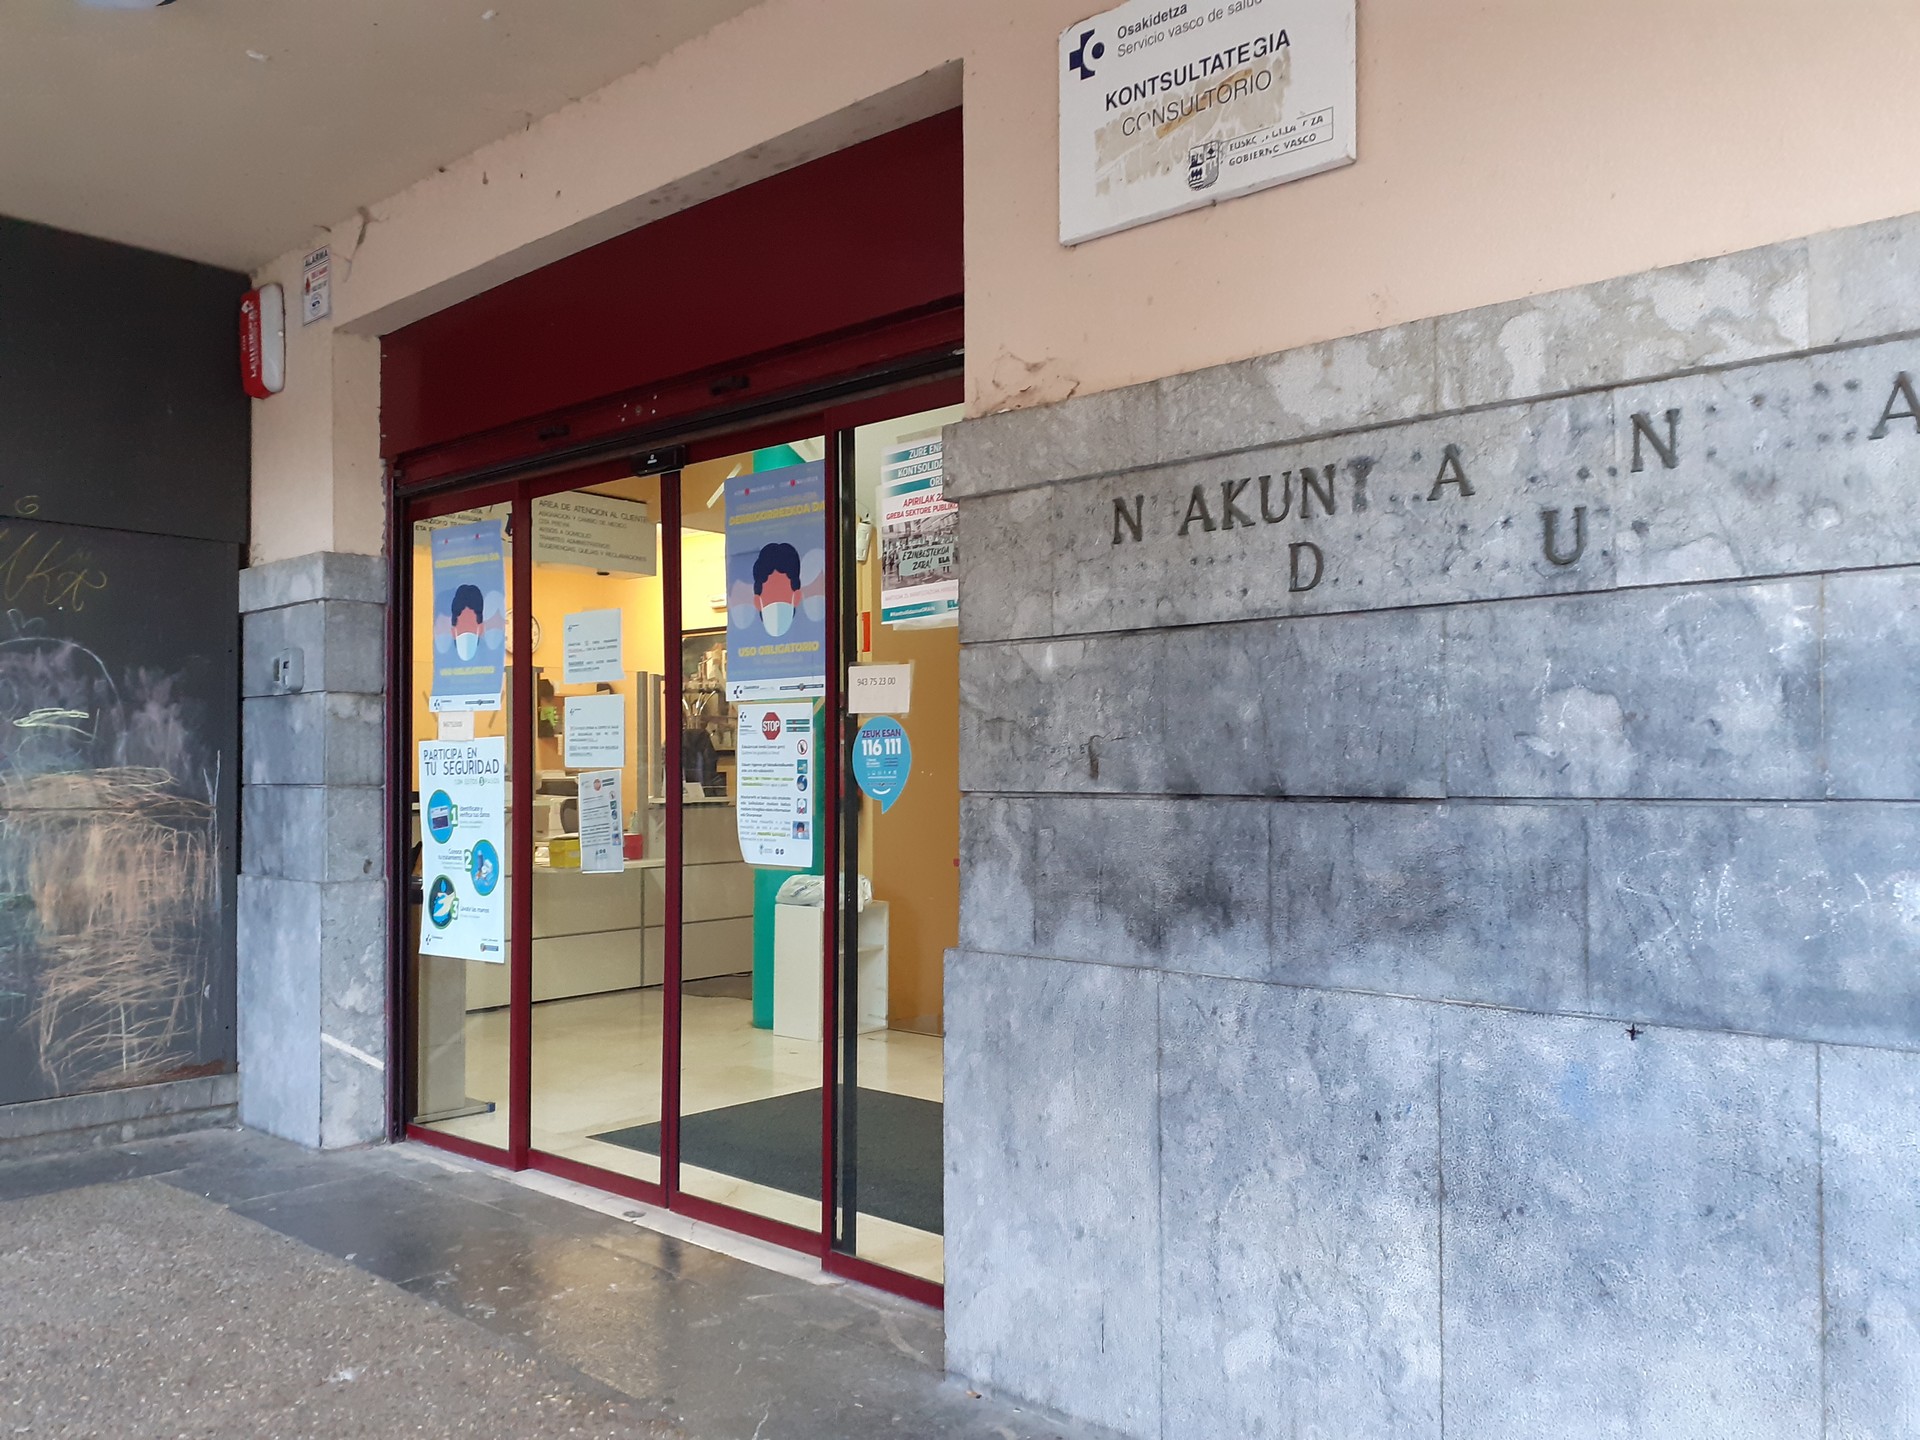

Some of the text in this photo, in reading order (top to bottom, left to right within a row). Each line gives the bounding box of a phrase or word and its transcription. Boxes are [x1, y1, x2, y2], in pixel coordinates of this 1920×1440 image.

[1117, 4, 1187, 39] Osakidetza
[1117, 31, 1165, 58] Servicio
[1167, 16, 1204, 38] vasco
[1208, 8, 1223, 23] de
[1105, 29, 1290, 112] KONTSULTATEGIA
[1122, 70, 1272, 137] CONSULTORIO
[1284, 133, 1317, 150] VASCO
[909, 446, 928, 459] ZURE
[857, 677, 896, 686] 943 75 23 00
[762, 720, 780, 732] STOP
[862, 728, 902, 738] ZEUK ESAN
[423, 747, 478, 760] PARTICIPA EN
[862, 738, 902, 756] 116 111
[425, 759, 500, 776] TU SEGURIDAD
[464, 850, 472, 870] 2
